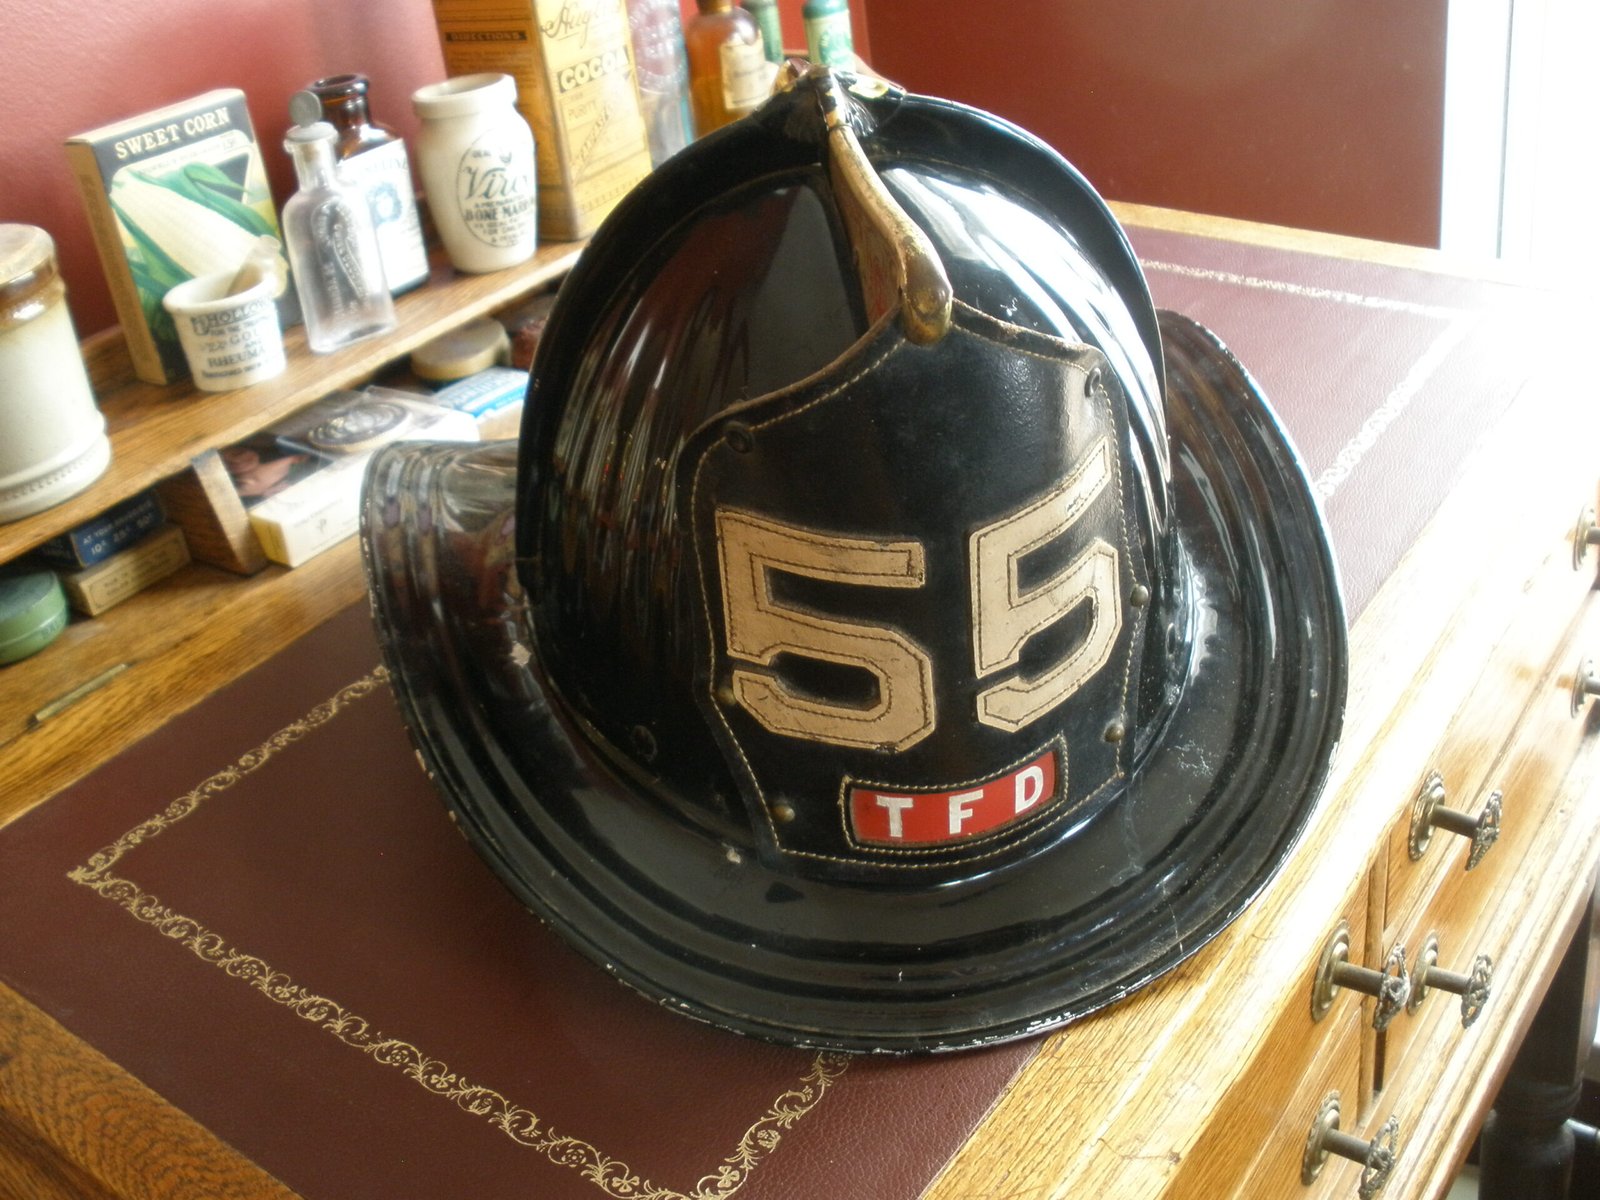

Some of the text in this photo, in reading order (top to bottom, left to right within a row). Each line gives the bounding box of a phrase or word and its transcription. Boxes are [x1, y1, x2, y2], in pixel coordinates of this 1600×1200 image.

[559, 48, 629, 91] COCOA
[114, 123, 182, 160] SWEET
[183, 106, 231, 136] CORN
[463, 208, 498, 223] BONE
[715, 434, 1123, 752] 55
